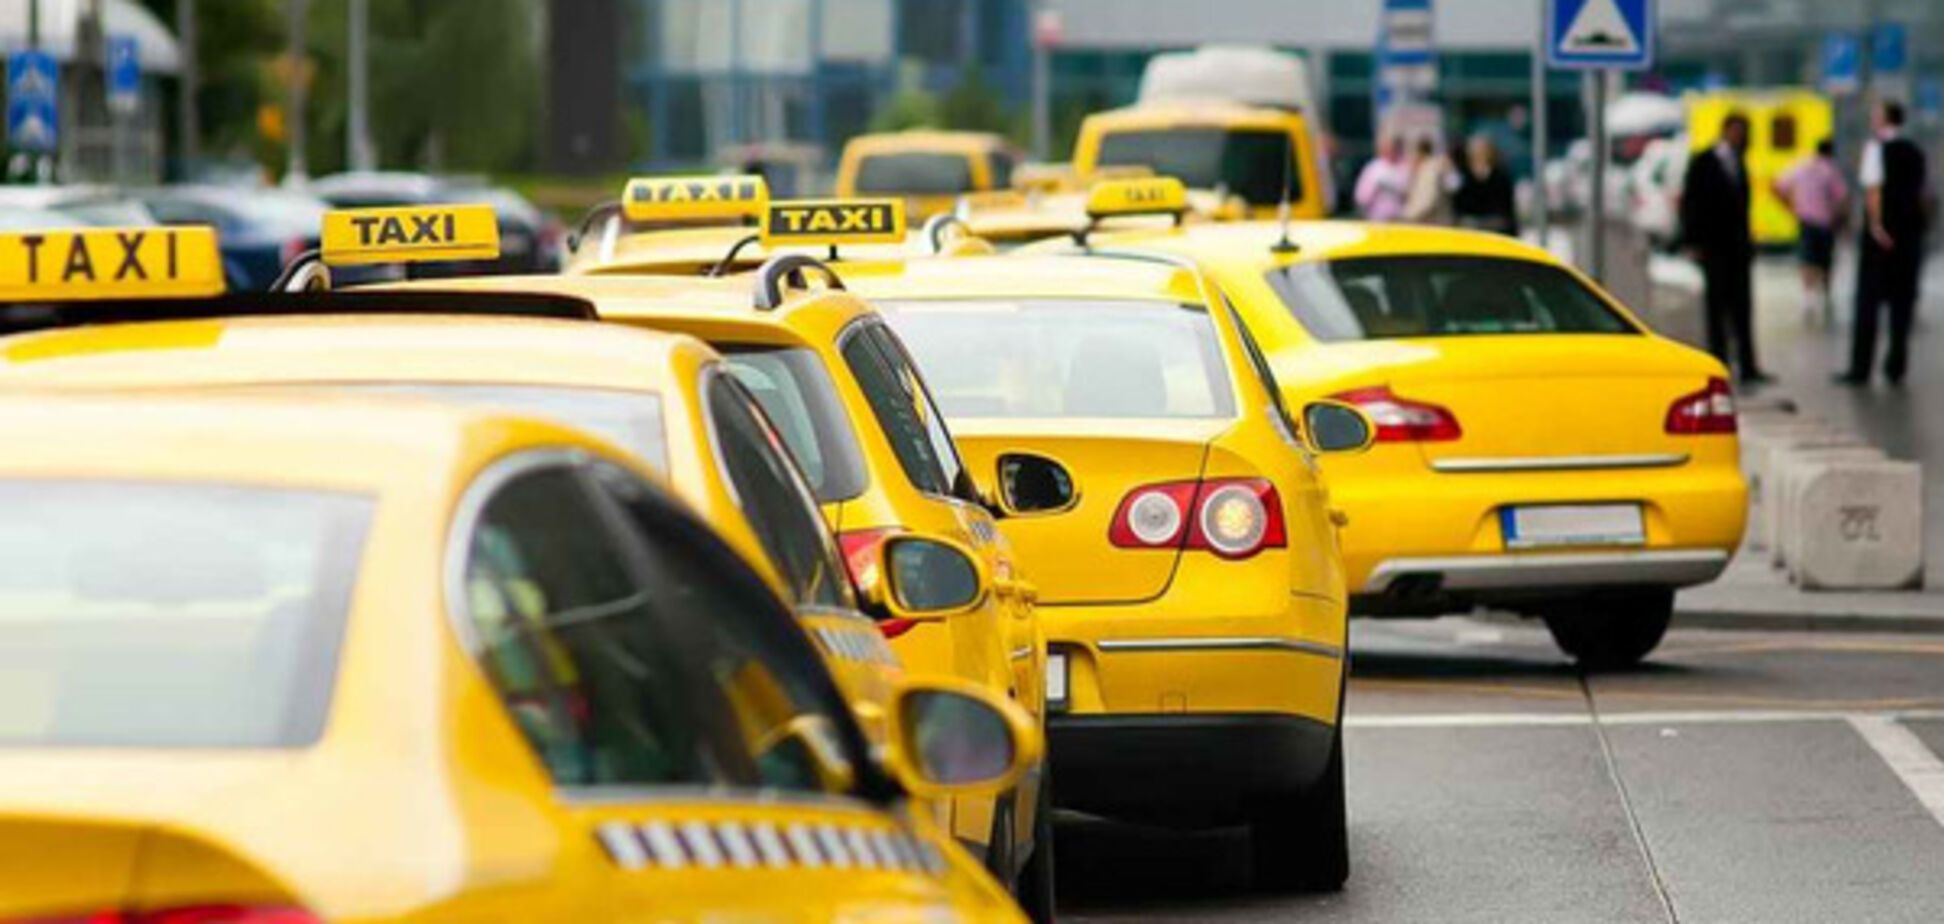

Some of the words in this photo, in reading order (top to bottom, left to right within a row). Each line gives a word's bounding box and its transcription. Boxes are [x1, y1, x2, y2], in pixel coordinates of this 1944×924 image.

[647, 181, 740, 201] TAXI
[351, 213, 455, 246] TAXI
[781, 207, 883, 231] TAXI
[20, 231, 178, 283] TAXI
